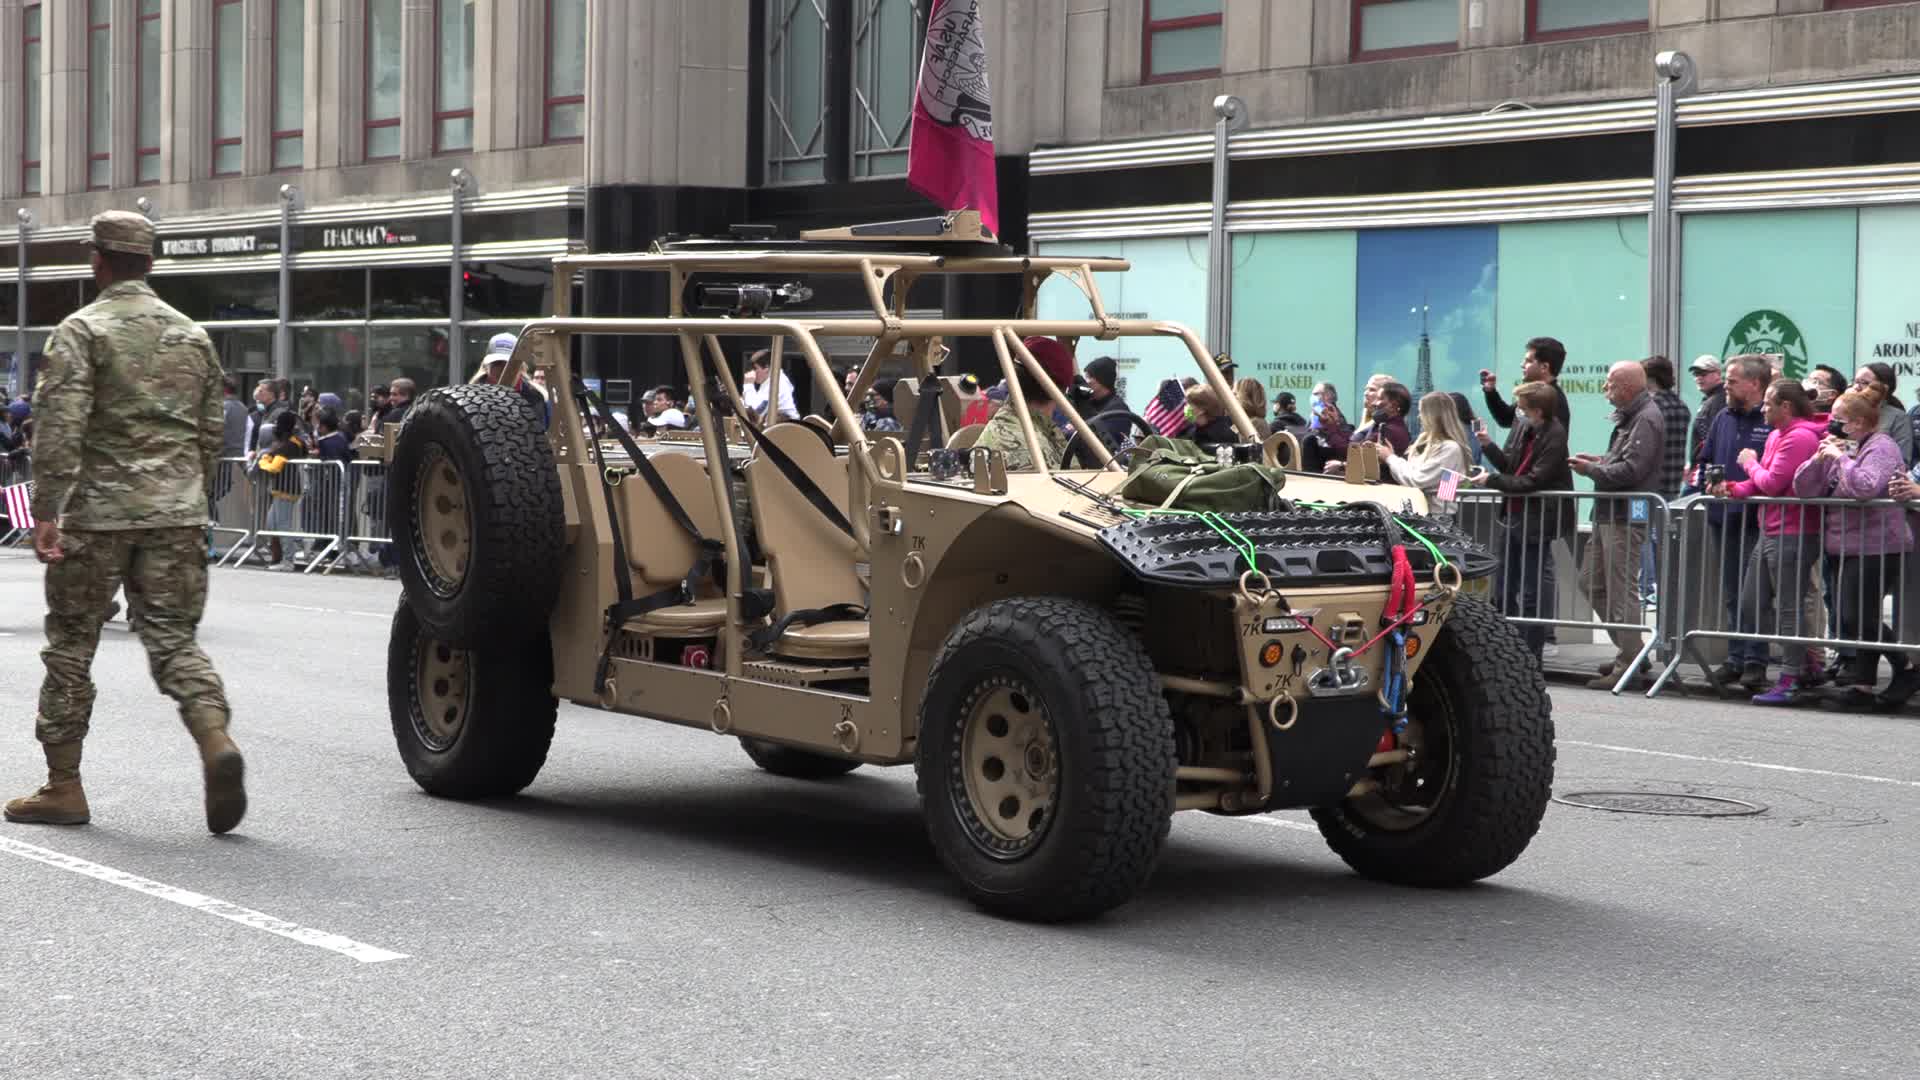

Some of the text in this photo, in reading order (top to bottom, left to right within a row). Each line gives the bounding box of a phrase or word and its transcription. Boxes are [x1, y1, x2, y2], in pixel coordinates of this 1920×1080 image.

[323, 226, 386, 247] PHARMACY
[1905, 322, 1920, 338] NE
[1872, 343, 1920, 358] AROUN
[1290, 363, 1326, 371] CORNER
[1270, 376, 1313, 389] LEASED
[912, 536, 926, 550] 7K
[1429, 612, 1445, 624] 7K
[1243, 624, 1262, 636] 7K
[1274, 674, 1293, 688] 7K
[840, 704, 853, 718] 7K
